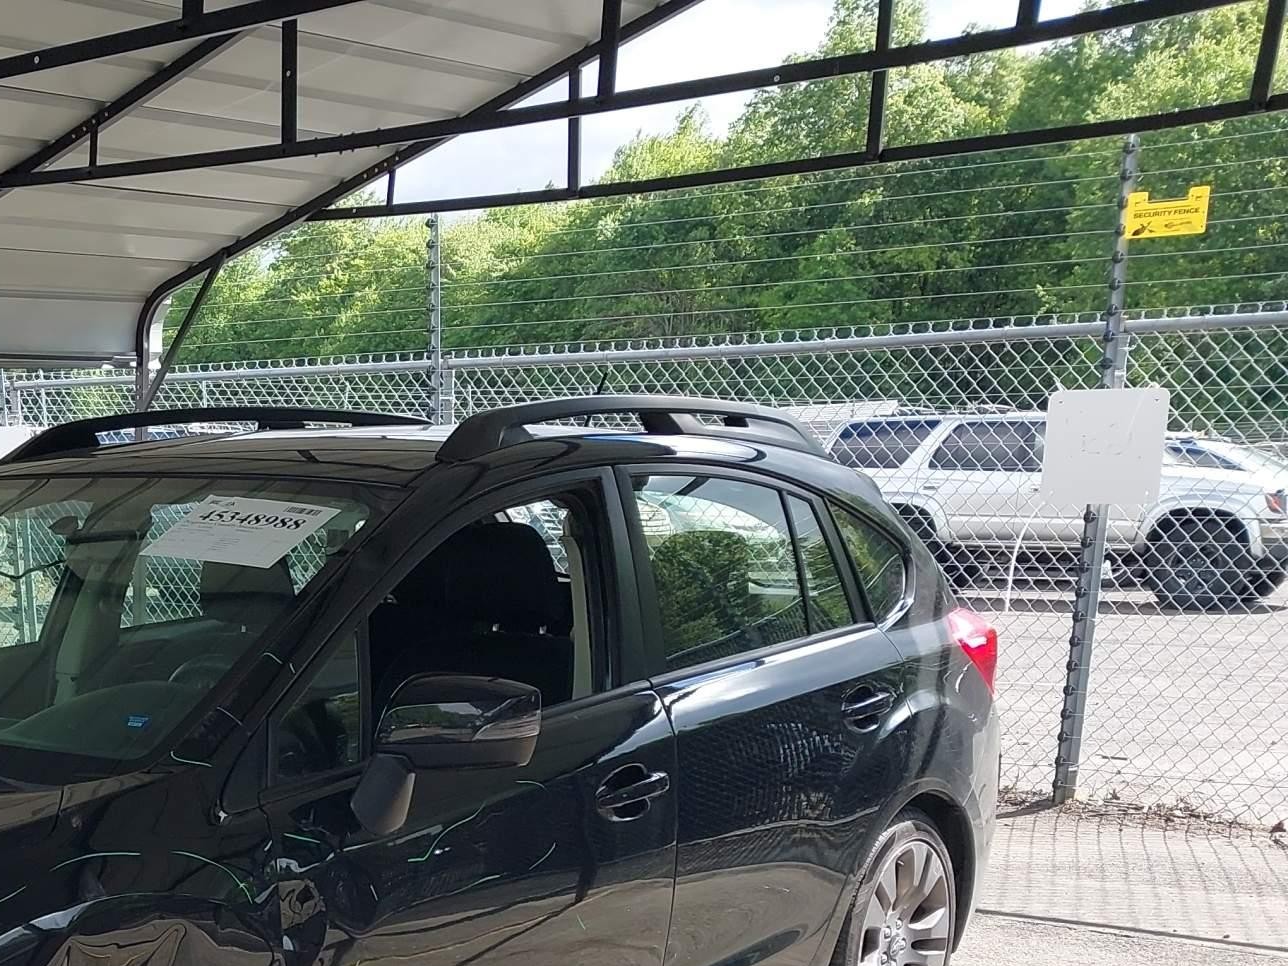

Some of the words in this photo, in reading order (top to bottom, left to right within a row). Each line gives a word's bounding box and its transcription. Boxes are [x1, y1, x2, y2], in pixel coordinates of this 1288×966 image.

[1133, 210, 1173, 219] SECURITY
[1173, 207, 1201, 216] FENCE
[199, 510, 307, 530] 45348988
